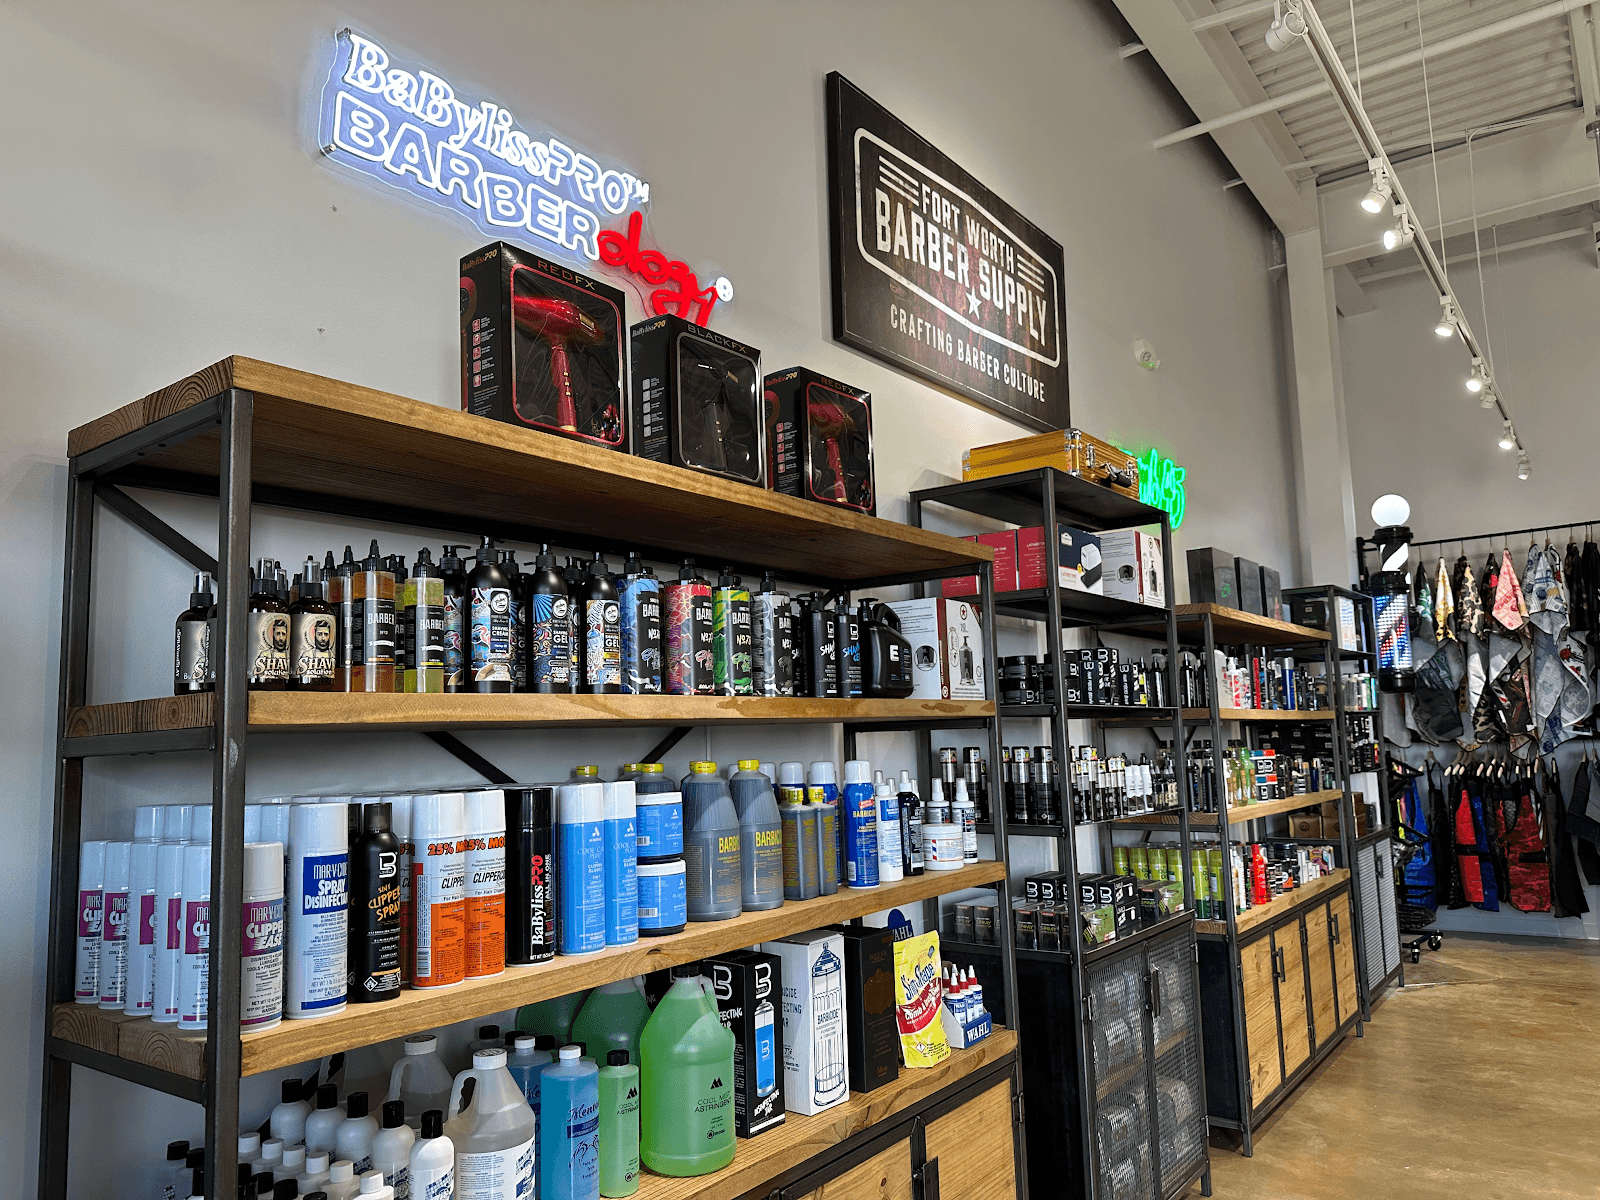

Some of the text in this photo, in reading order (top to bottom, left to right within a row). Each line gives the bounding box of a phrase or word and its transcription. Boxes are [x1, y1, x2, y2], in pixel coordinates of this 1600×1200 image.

[920, 183, 1015, 275] FORT WORTH
[537, 259, 596, 291] REDFX
[875, 187, 1047, 347] BARBER SUPPLY
[687, 323, 747, 354] BLACKFX
[890, 303, 1045, 403] CRAFTING BARBER CULTURE
[820, 376, 855, 396] REDFX
[427, 842, 455, 857] 25%
[318, 878, 346, 896] SPRAY
[531, 854, 547, 946] BaBylissPRO
[893, 926, 913, 941] AHL
[817, 1008, 839, 1025] BARBICIDE
[966, 1021, 990, 1043] WAHL
[697, 1097, 717, 1106] COOL
